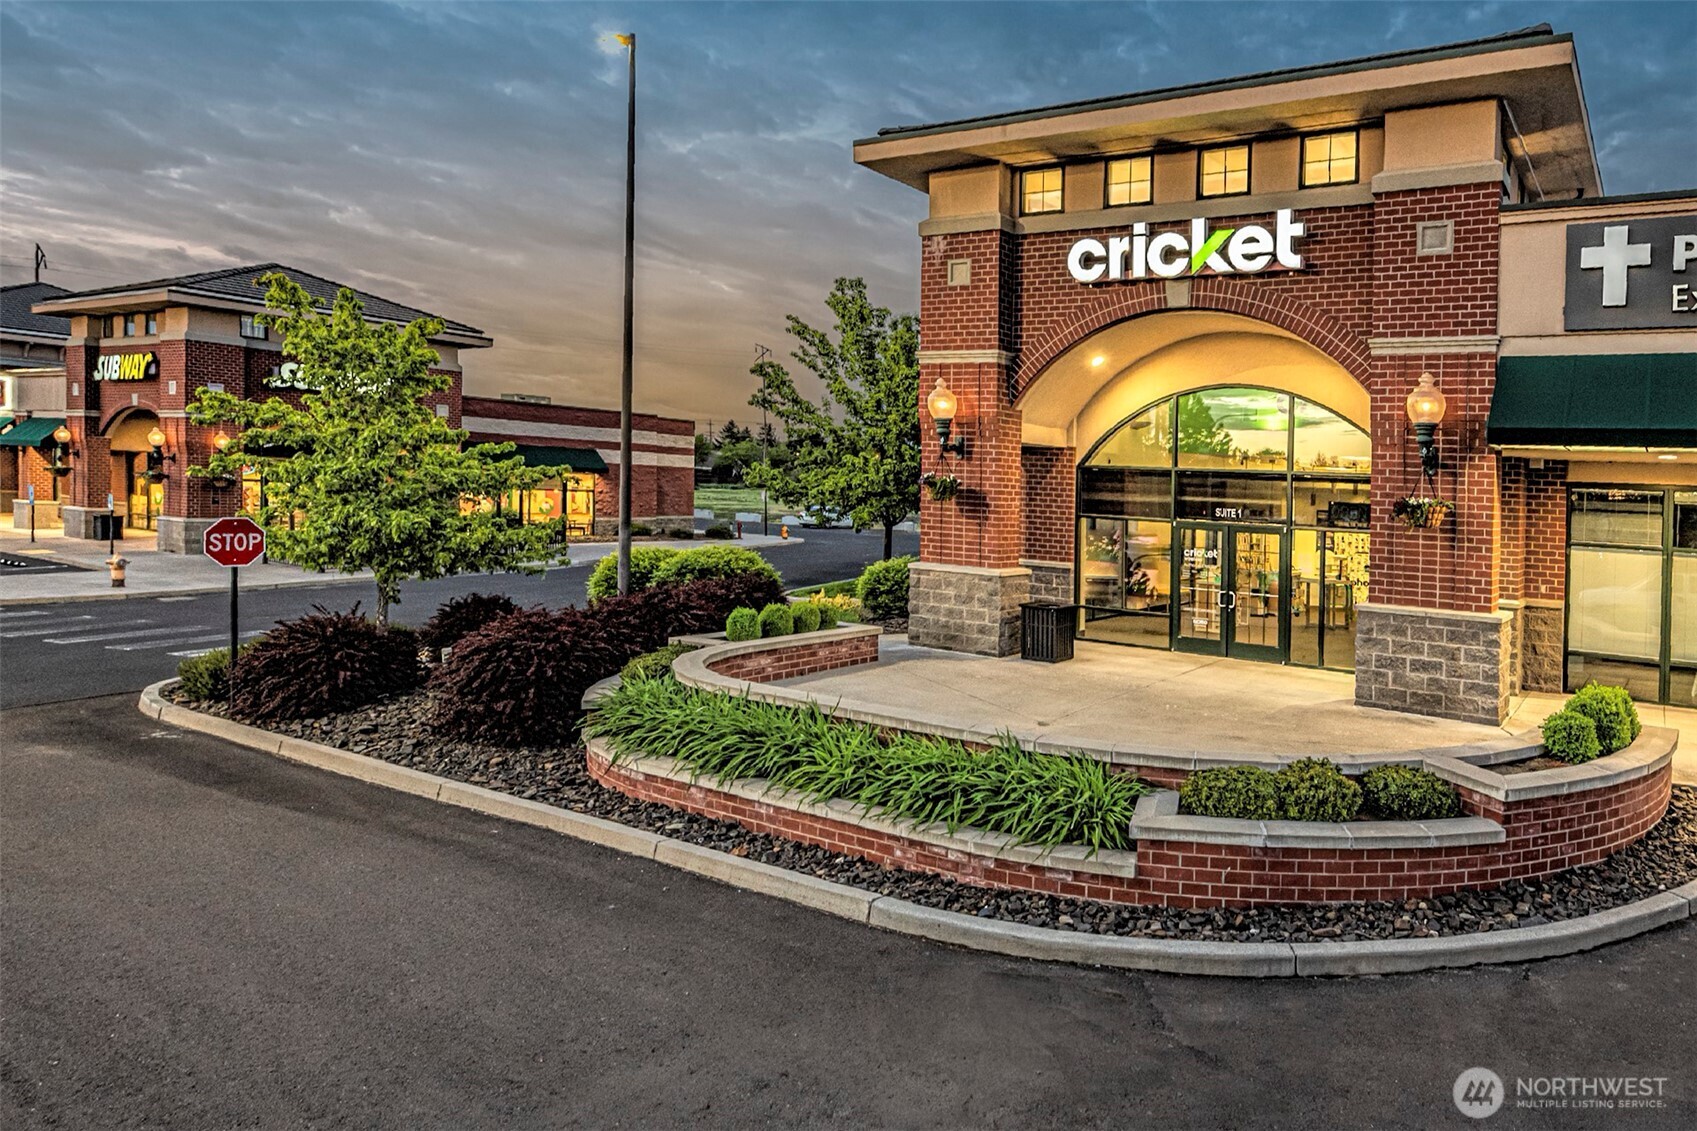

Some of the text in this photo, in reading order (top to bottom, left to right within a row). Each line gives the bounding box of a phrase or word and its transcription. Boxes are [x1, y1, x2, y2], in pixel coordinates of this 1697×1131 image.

[1067, 208, 1304, 283] cricket
[93, 352, 153, 380] SUBWAY
[1215, 507, 1242, 518] SUITE 1
[209, 532, 262, 552] STOP
